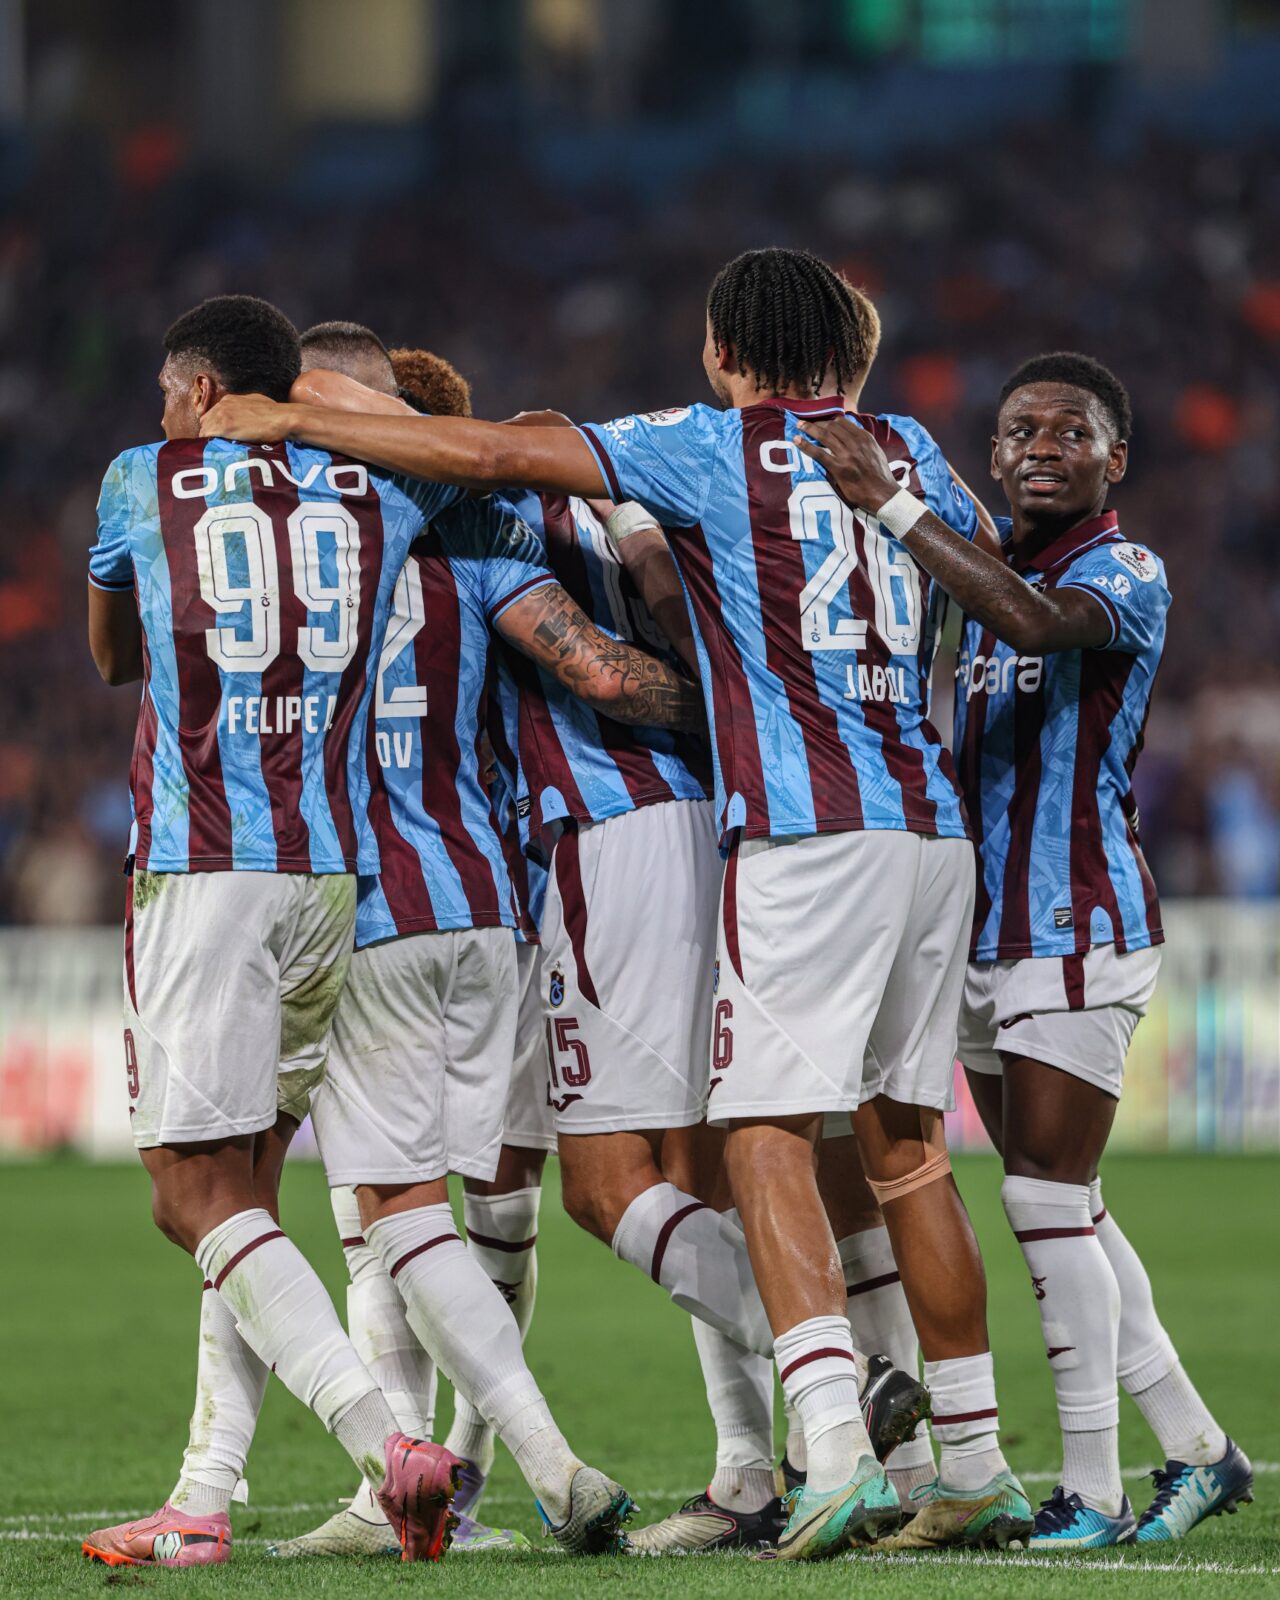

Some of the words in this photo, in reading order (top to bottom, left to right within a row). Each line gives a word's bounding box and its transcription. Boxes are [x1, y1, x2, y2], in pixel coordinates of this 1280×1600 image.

[193, 501, 362, 673] 99
[787, 480, 923, 656] 26
[227, 696, 320, 734] FELIPE
[843, 664, 910, 705] JABOL
[546, 1017, 592, 1088] 15
